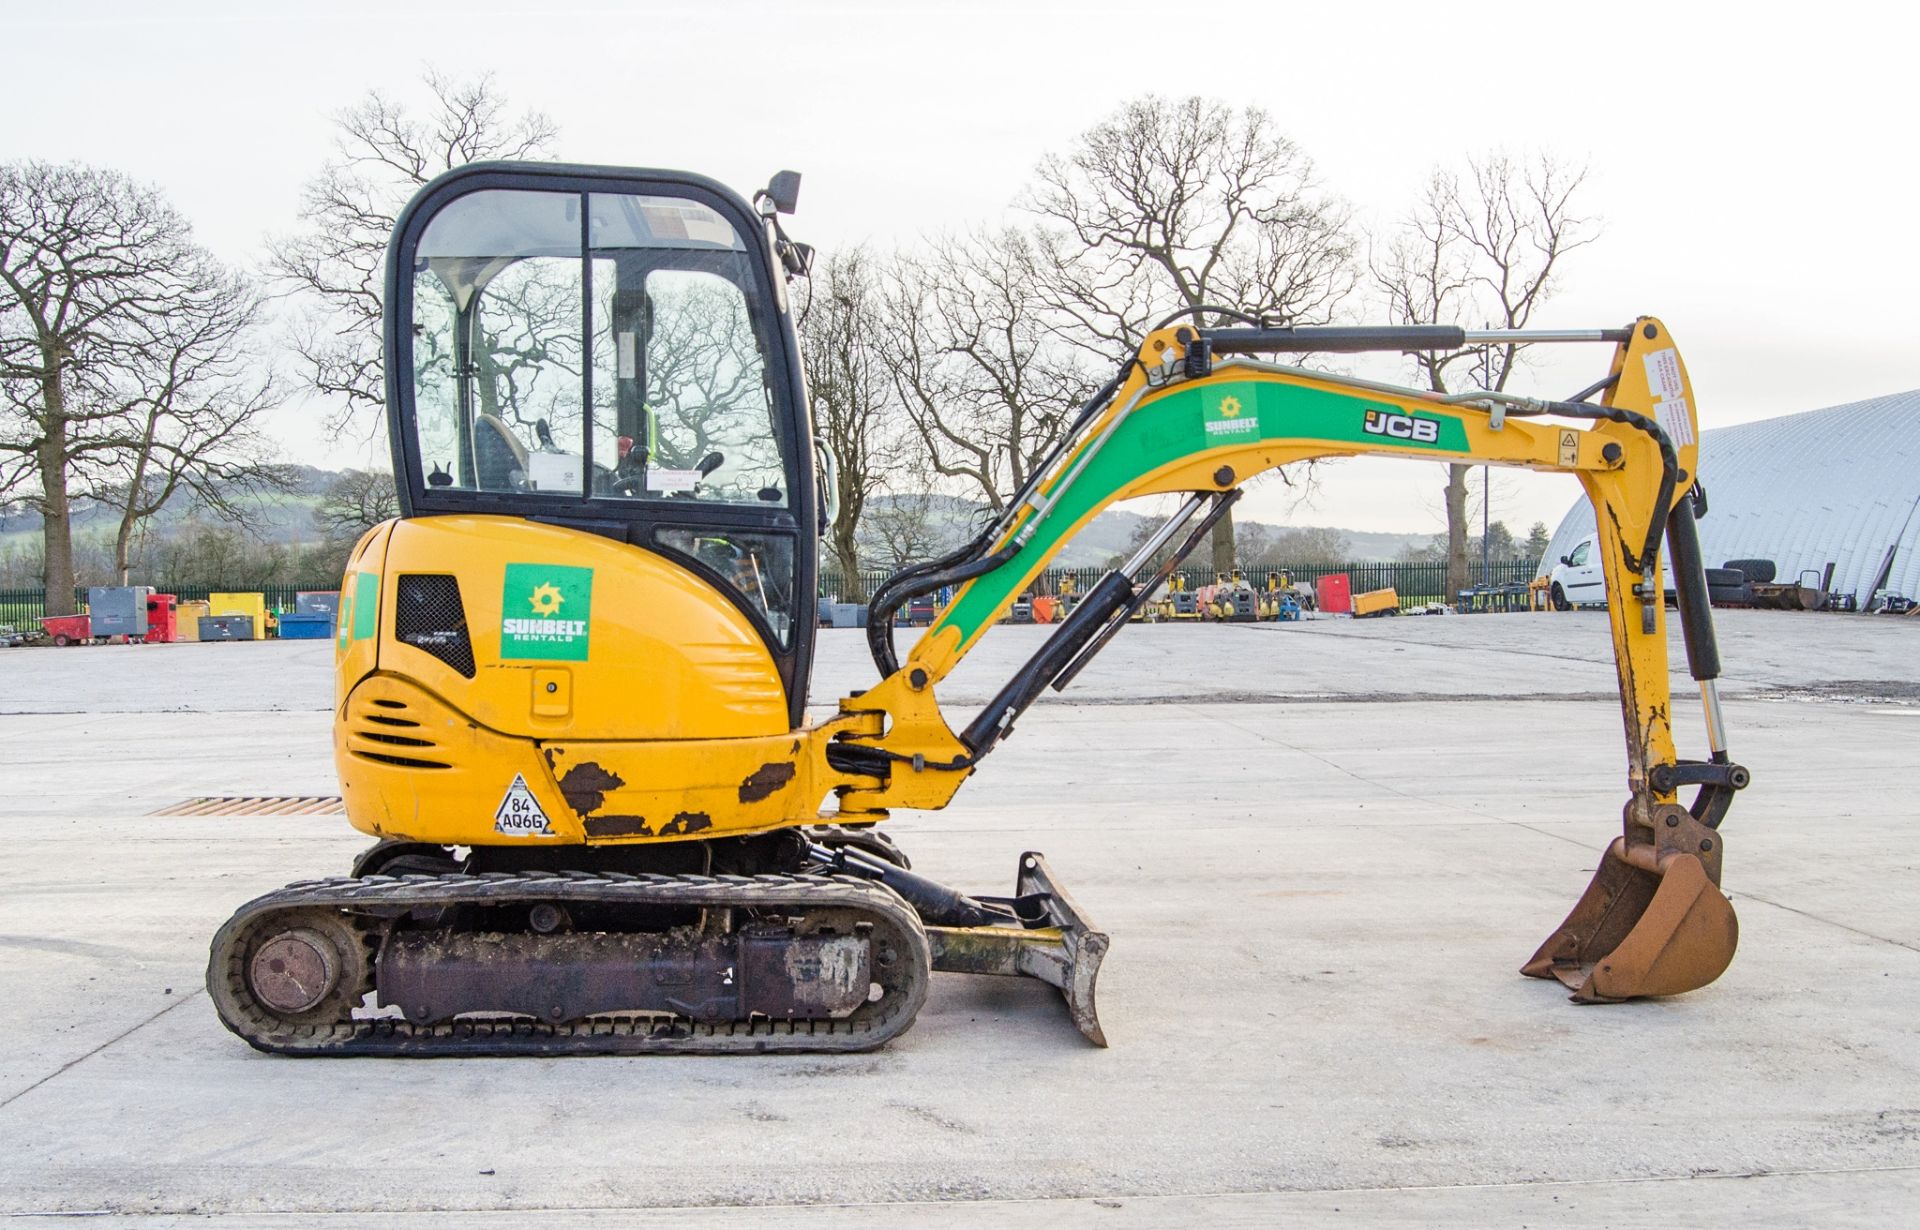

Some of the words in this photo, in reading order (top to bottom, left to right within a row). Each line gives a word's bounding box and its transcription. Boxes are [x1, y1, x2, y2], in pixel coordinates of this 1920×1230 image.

[1204, 417, 1259, 432] SUNBELT
[1365, 411, 1438, 443] JCB
[503, 618, 586, 636] SUNBELT
[513, 633, 573, 642] RENTALS
[512, 798, 530, 813] 84
[503, 813, 543, 829] AQ6G
